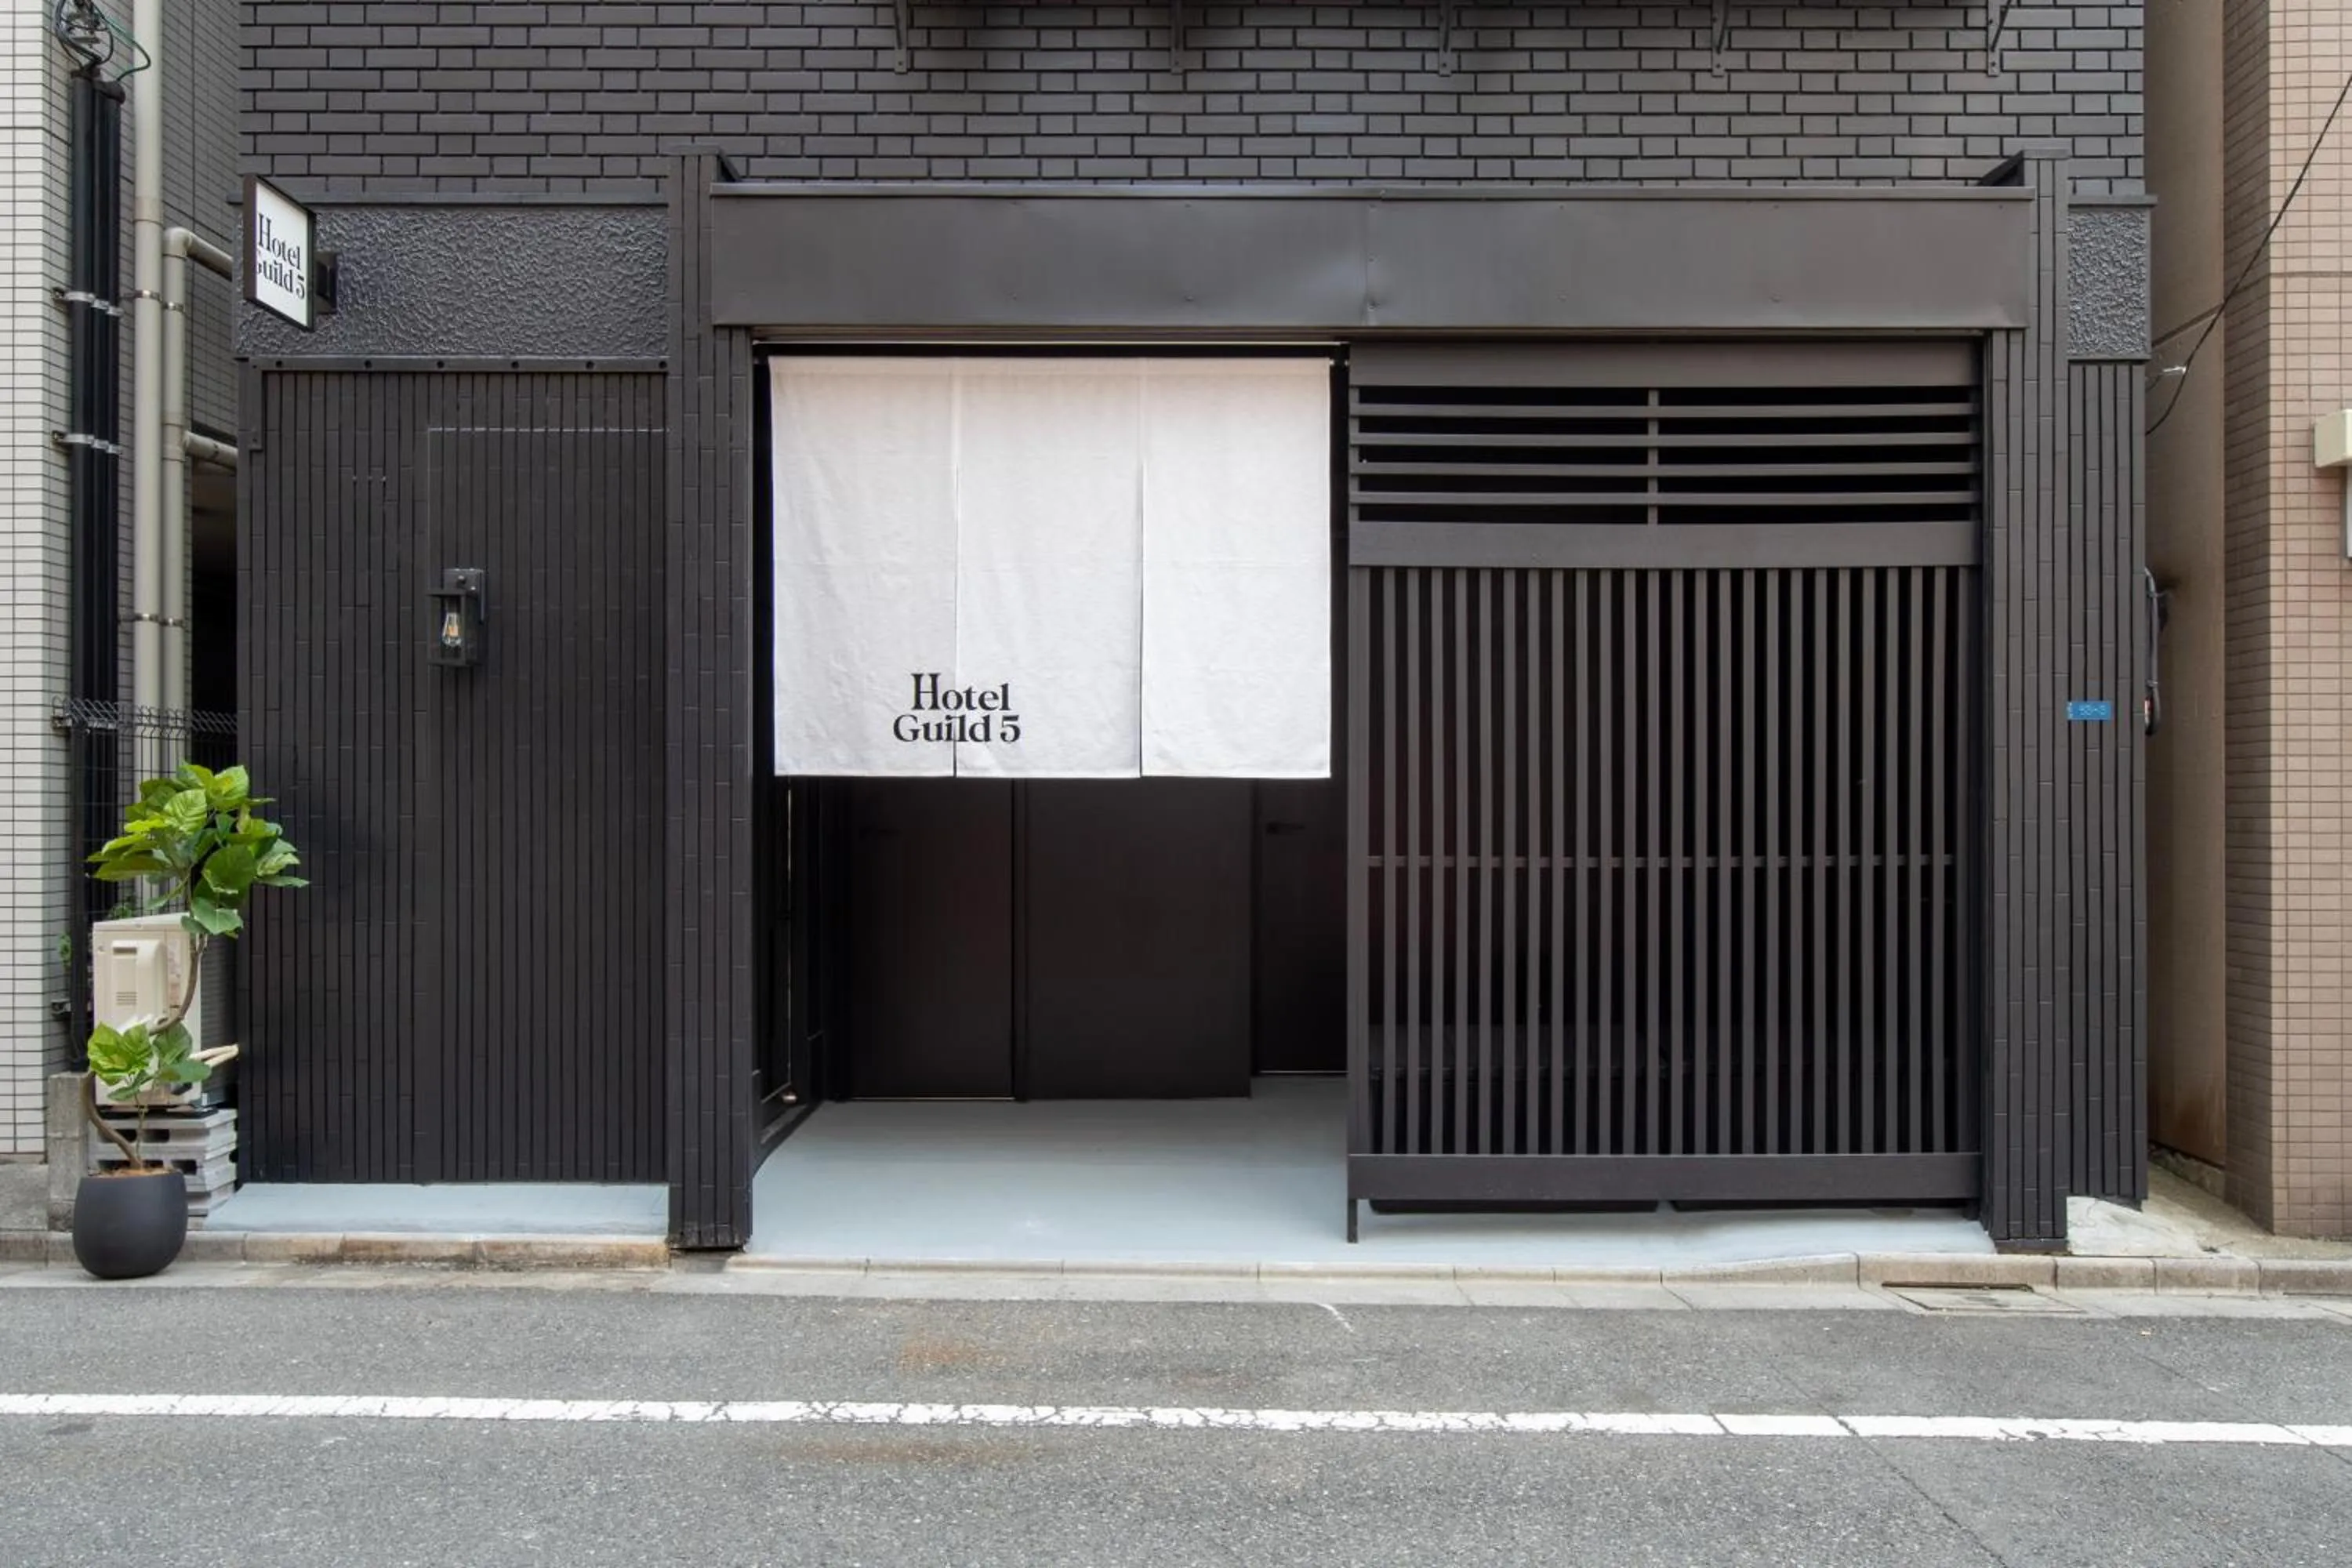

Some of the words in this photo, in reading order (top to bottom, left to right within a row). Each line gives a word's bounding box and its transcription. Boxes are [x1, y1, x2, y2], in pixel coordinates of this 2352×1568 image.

[258, 212, 301, 270] Hotel
[296, 274, 306, 300] 5
[910, 672, 1012, 711] Hotel
[892, 713, 992, 742] Guild
[999, 714, 1022, 742] 5
